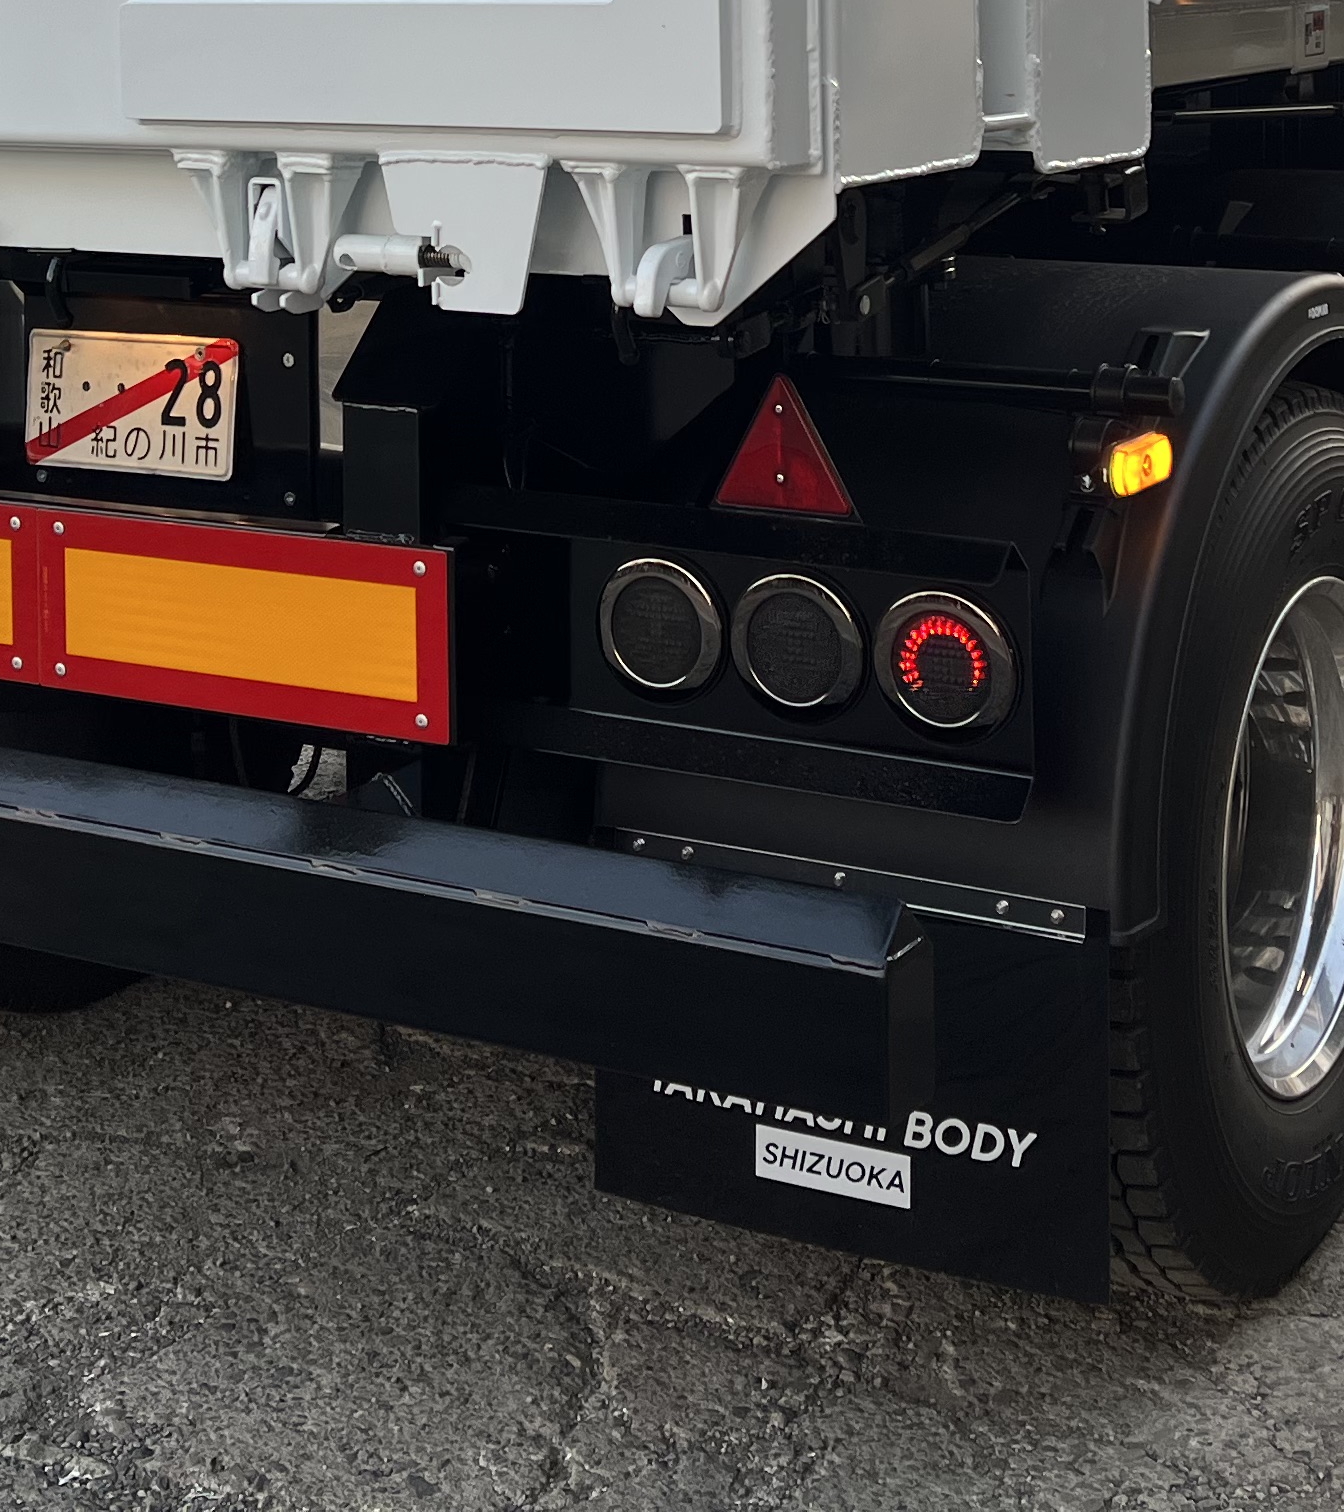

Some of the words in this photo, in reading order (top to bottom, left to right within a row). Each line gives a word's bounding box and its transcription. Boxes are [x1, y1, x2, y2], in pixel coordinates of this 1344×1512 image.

[38, 348, 63, 449] 和歌山
[90, 424, 220, 467] 紀の川市
[903, 1110, 1038, 1169] BODY
[762, 1142, 906, 1195] SHIZUOKA
